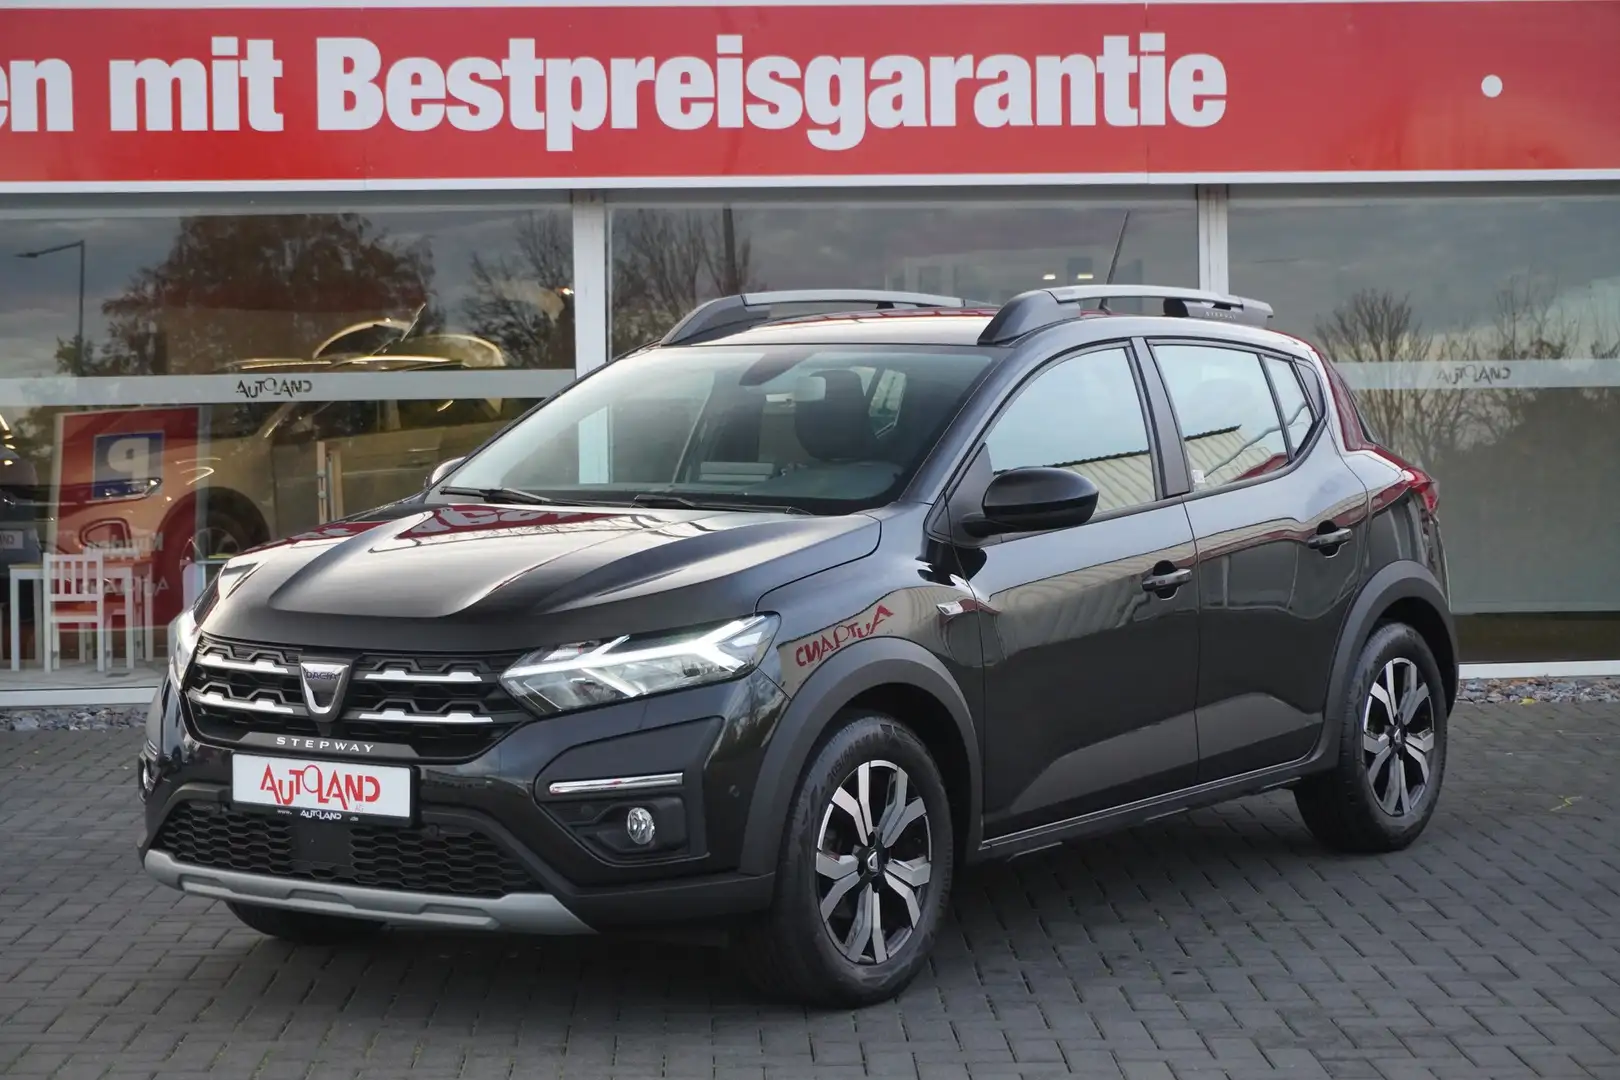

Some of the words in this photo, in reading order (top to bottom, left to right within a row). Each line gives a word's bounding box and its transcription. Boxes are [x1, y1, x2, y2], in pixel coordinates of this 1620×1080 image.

[0, 58, 74, 132] n
[109, 36, 283, 131] mit
[316, 32, 1228, 152] Bestpreisgarantie
[1437, 364, 1512, 385] AUTOLAND
[236, 377, 313, 398] AUTOLAND
[305, 671, 338, 681] DACIA
[276, 736, 374, 753] STEPWAY
[260, 763, 381, 811] AUTOLAND
[300, 809, 342, 821] AUTOLAND
